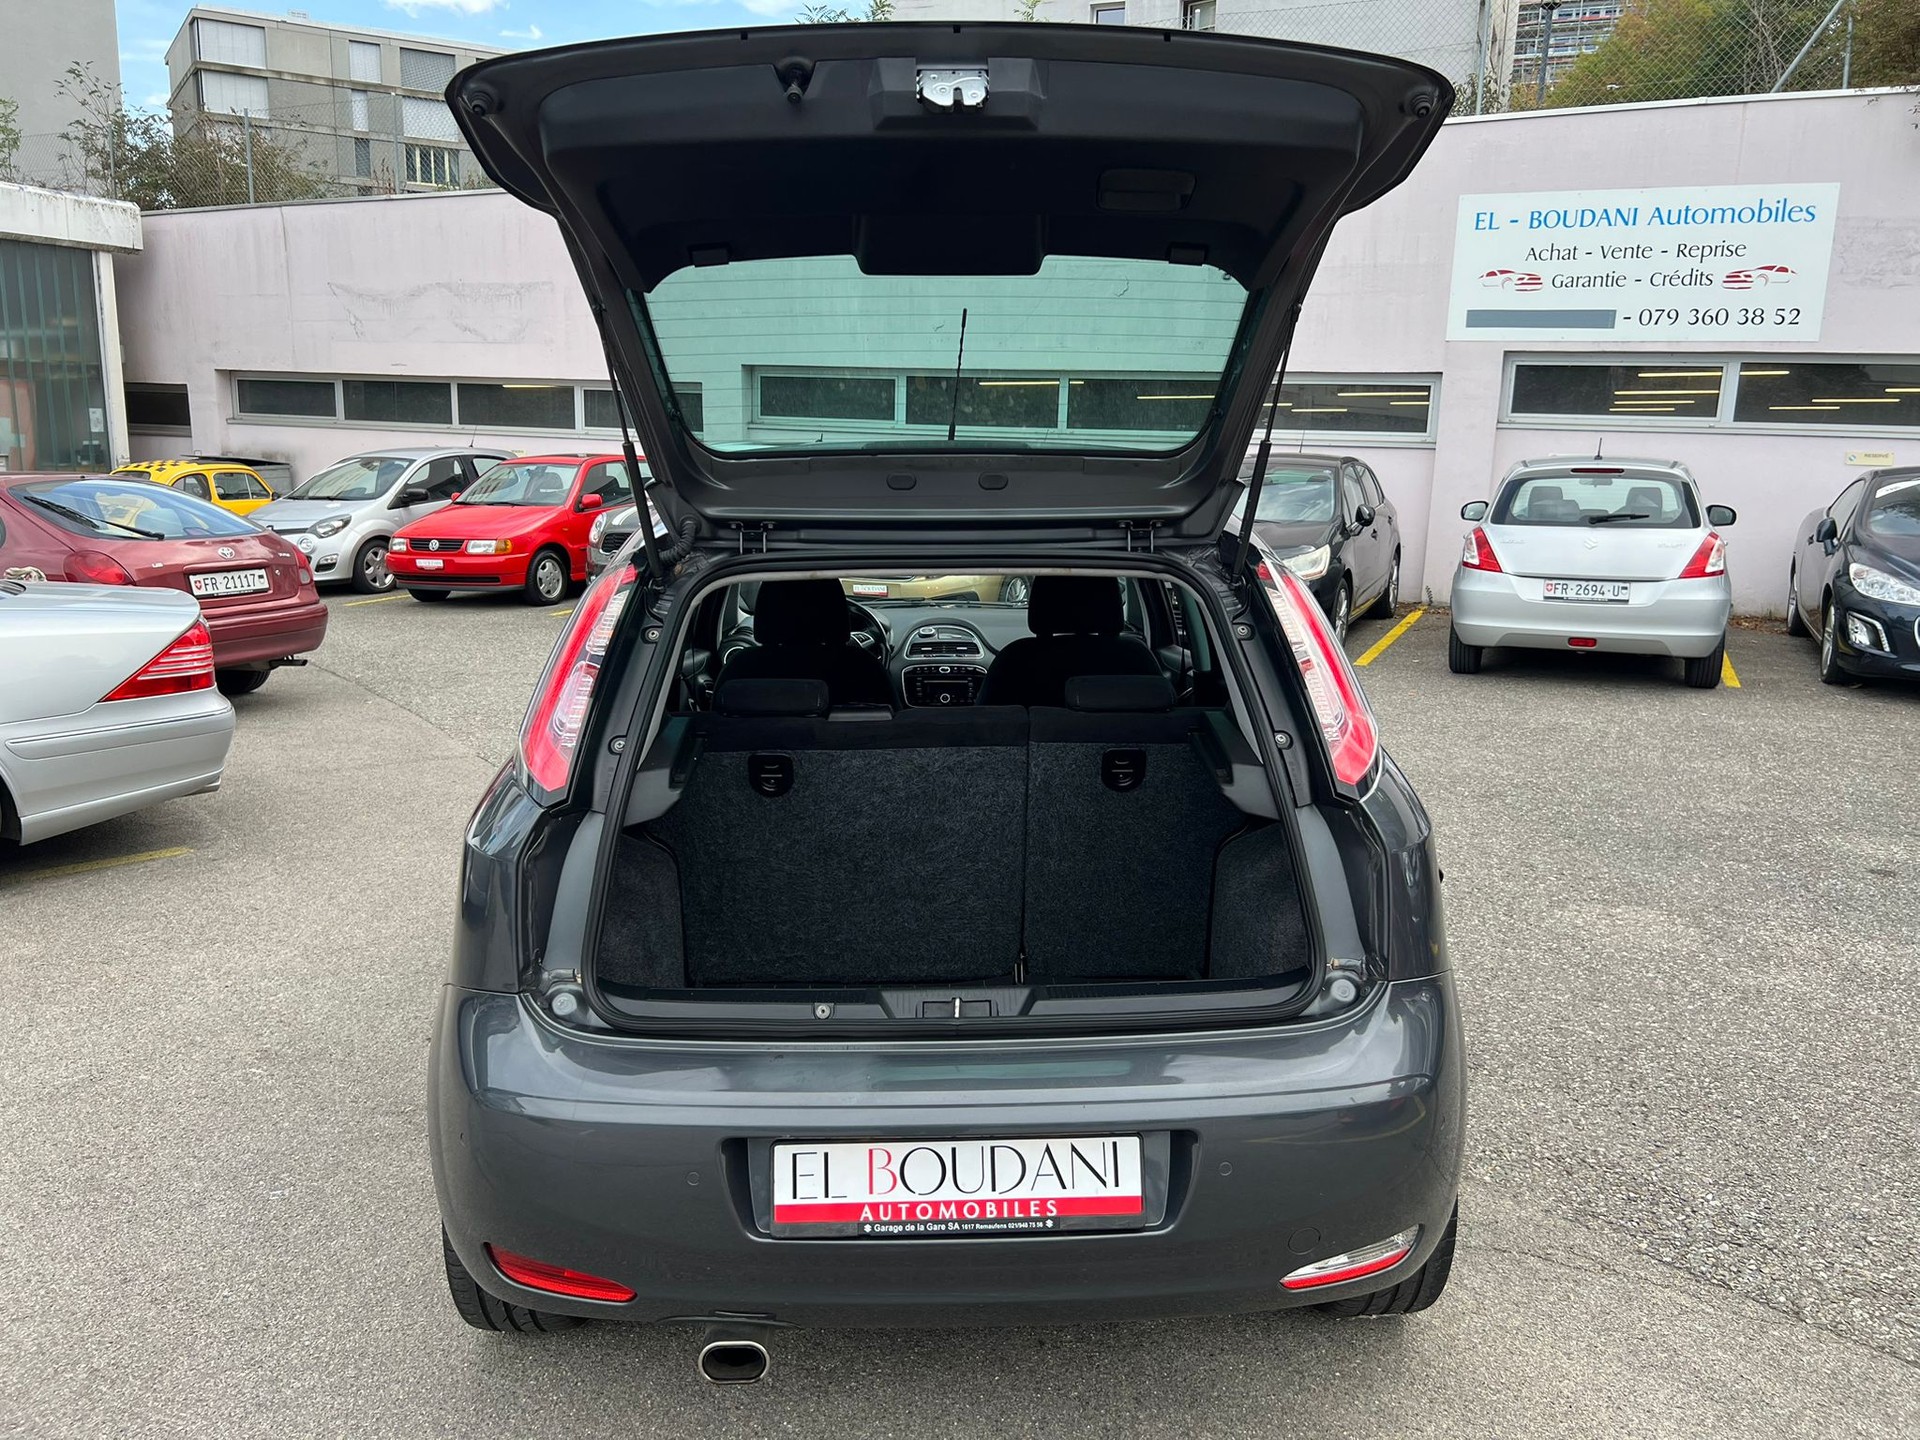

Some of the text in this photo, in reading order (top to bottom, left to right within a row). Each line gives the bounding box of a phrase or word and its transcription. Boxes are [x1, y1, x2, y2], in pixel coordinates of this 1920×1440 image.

[1474, 211, 1500, 231] EL
[1528, 207, 1639, 230] BOUDANI
[1647, 198, 1817, 226] Automobiles
[1525, 243, 1579, 262] Achat
[1600, 244, 1653, 260] Vente
[1676, 240, 1747, 263] Reprise
[1551, 271, 1627, 289] Garantie
[1649, 268, 1714, 287] Crédits
[1638, 308, 1680, 326] 079
[1687, 308, 1730, 326] 360
[1736, 308, 1765, 326] 38
[1773, 308, 1801, 326] 52
[791, 1140, 1120, 1200] EL BOUDANI
[859, 1199, 1058, 1222] AUTOMOBILES
[873, 1223, 903, 1234] Garage
[904, 1223, 916, 1232] de
[917, 1222, 925, 1231] la
[926, 1222, 946, 1231] Gare
[947, 1221, 960, 1231] SA
